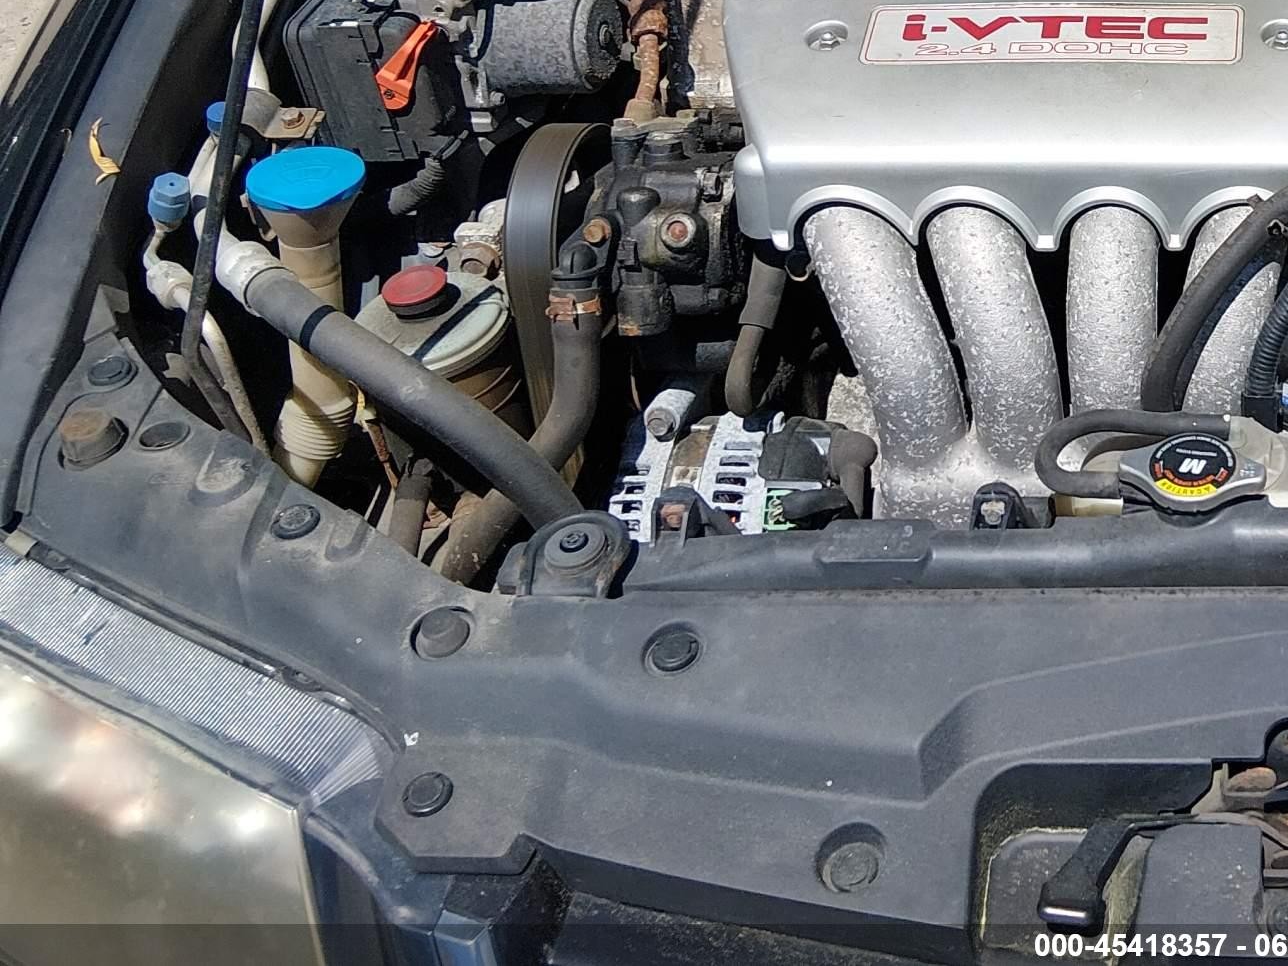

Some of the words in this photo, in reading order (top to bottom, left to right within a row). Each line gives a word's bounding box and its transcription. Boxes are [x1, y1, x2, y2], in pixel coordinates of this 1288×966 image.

[902, 14, 1209, 41] i-VTEC
[914, 42, 997, 57] 2.4
[1008, 41, 1190, 56] DOHC
